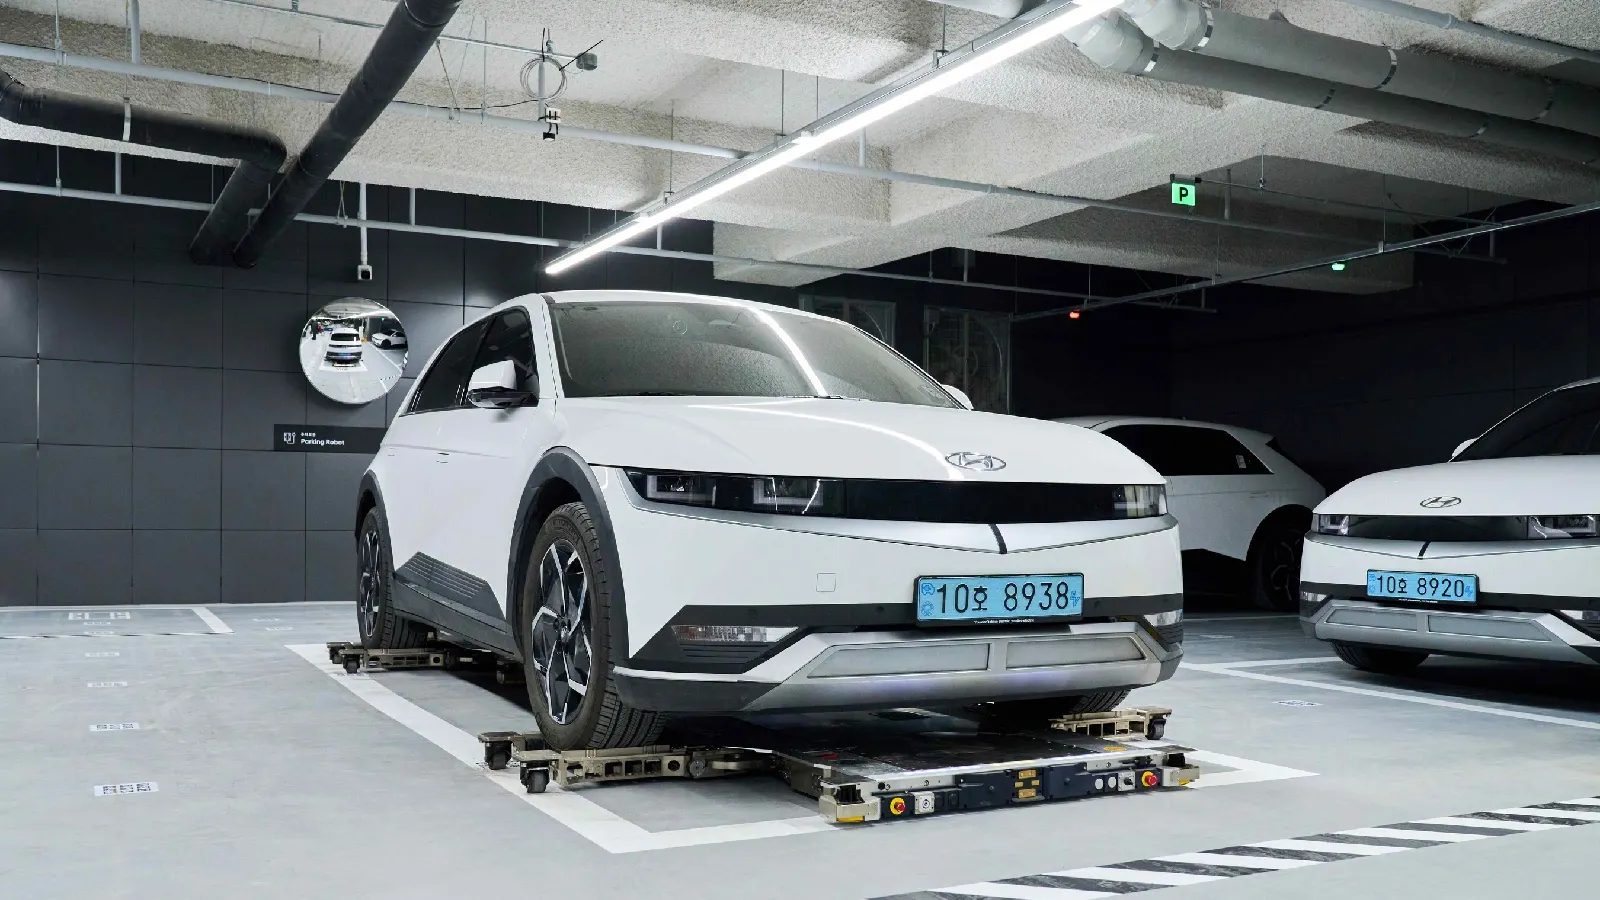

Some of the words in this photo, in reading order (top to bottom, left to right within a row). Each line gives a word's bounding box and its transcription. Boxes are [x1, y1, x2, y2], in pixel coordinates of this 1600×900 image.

[1179, 187, 1188, 201] P
[300, 438, 325, 446] Parking
[1377, 575, 1408, 594] 10호
[1417, 577, 1464, 598] 8920
[937, 583, 988, 613] 10호
[1004, 581, 1069, 612] 8938
